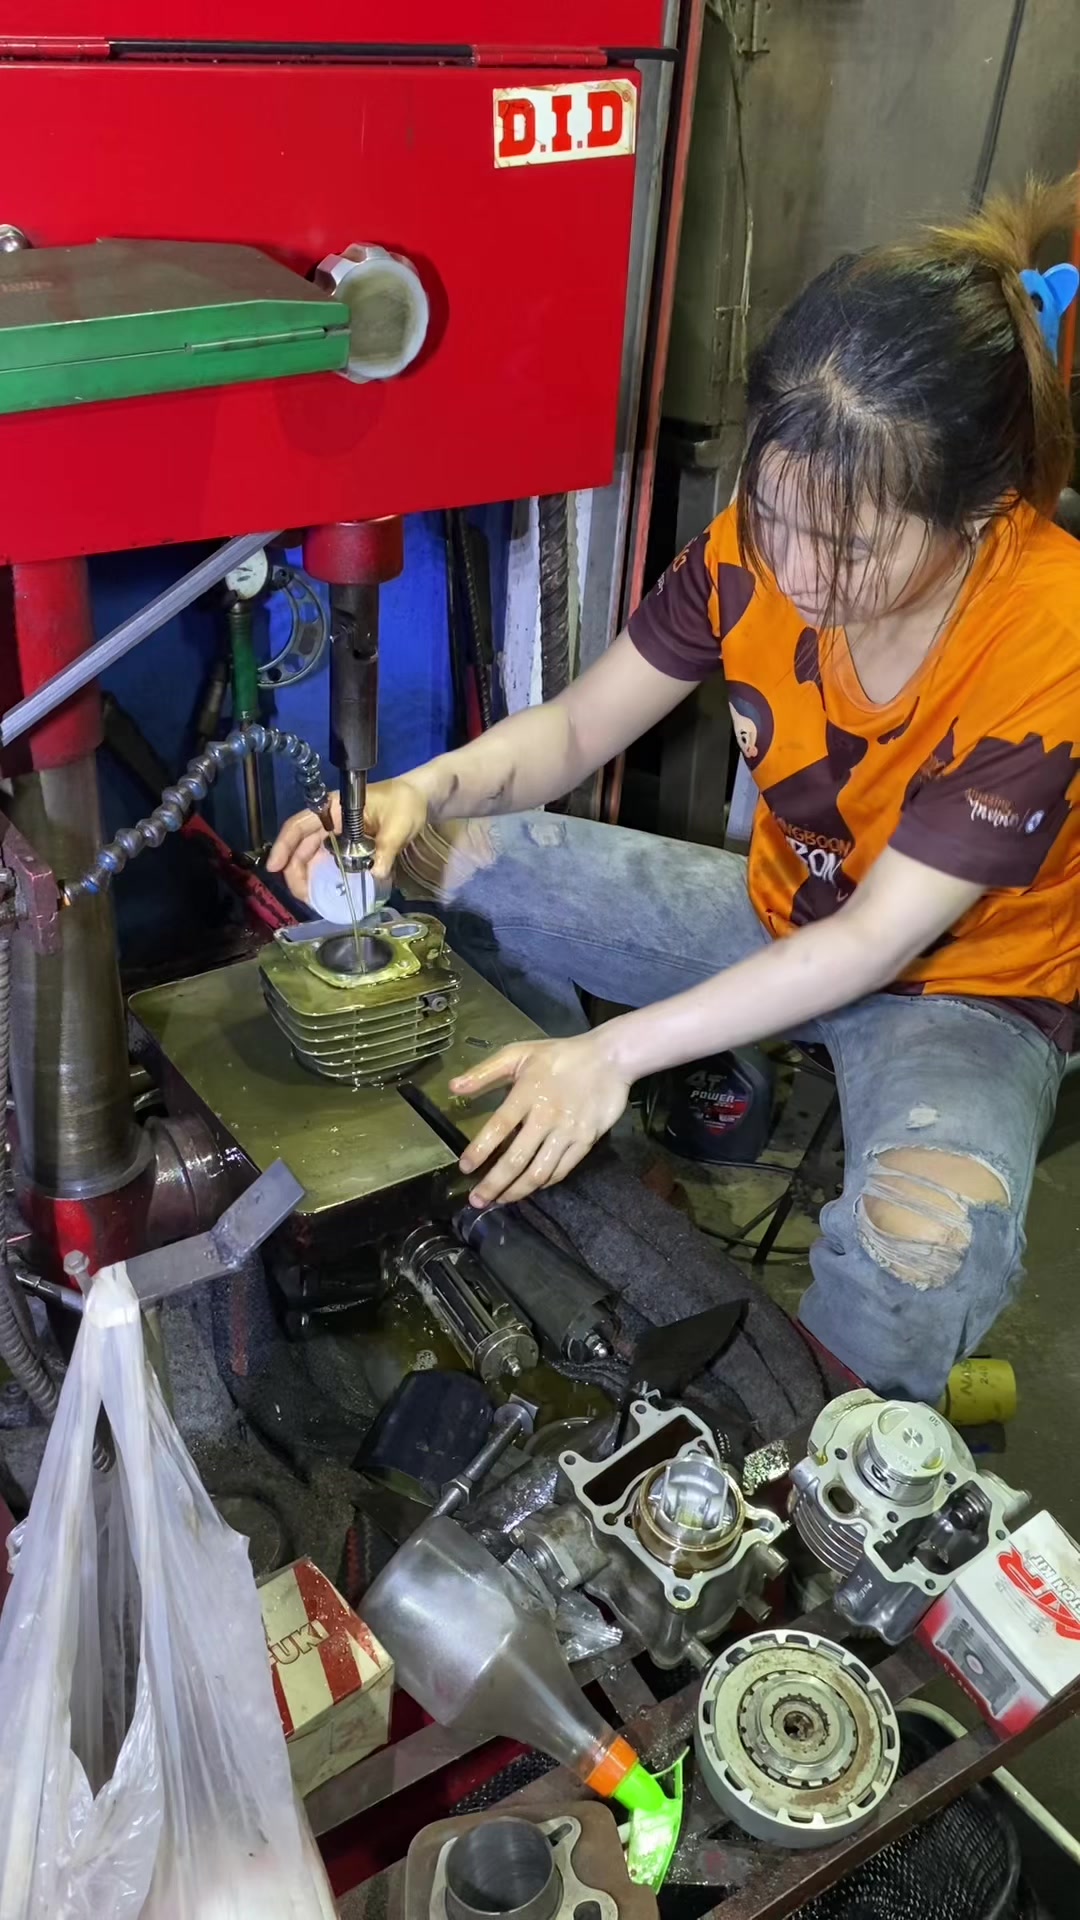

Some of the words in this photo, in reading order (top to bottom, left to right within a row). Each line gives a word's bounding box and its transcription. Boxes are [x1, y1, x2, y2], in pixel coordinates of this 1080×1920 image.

[498, 90, 623, 158] D.I.D
[690, 1089, 735, 1103] POWER
[1028, 1554, 1058, 1581] KIT
[267, 1619, 330, 1665] UKI
